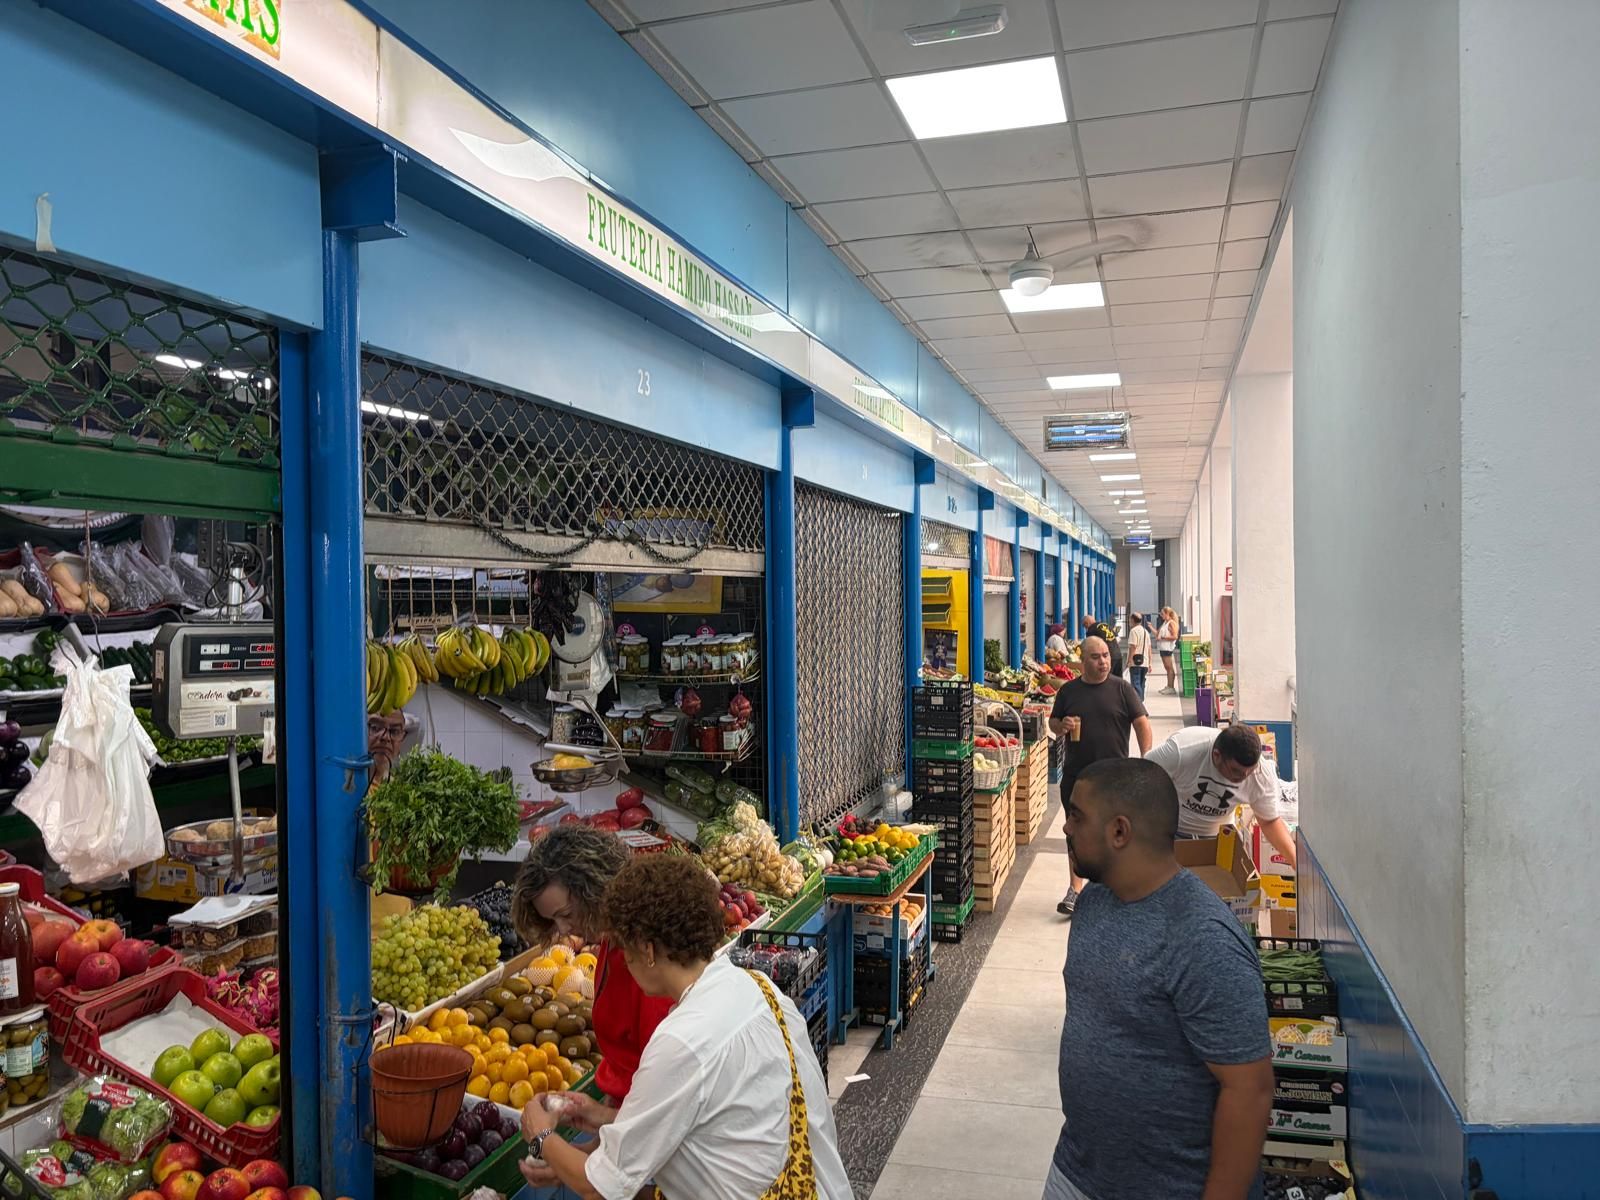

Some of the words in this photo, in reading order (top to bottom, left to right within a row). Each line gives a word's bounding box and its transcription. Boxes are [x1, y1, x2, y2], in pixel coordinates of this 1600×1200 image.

[587, 192, 662, 284] FRUTERIA
[667, 247, 711, 313] HAMIDO
[714, 280, 752, 339] HASSAN
[637, 368, 651, 397] 23
